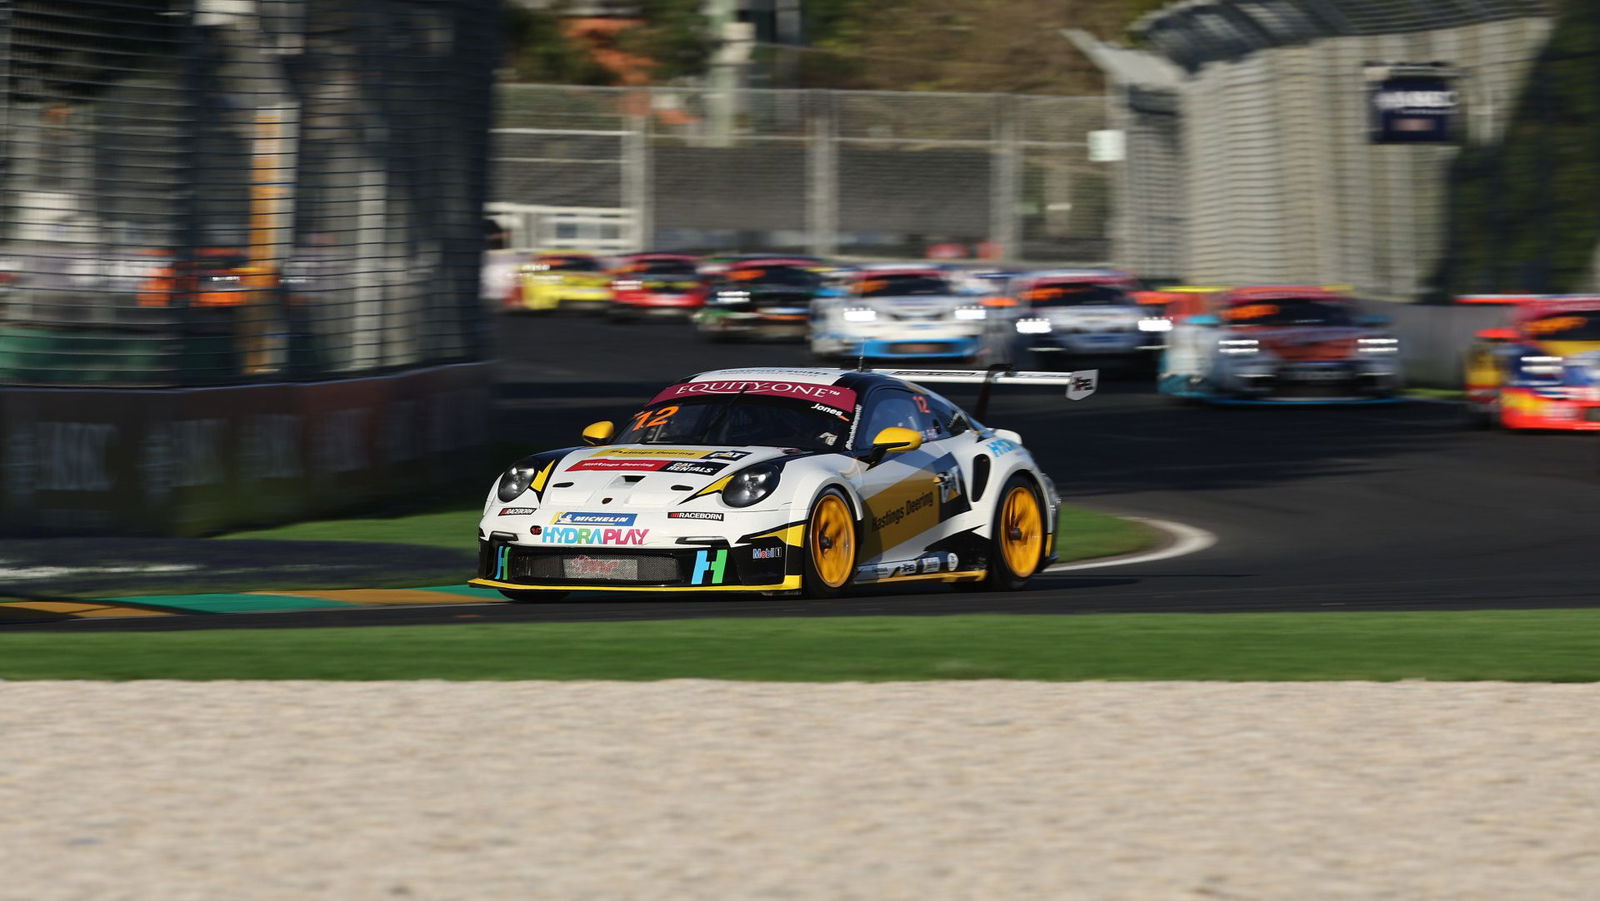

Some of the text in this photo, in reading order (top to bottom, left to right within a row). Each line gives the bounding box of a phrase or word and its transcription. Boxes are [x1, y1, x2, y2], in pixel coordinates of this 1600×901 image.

[811, 403, 843, 417] Jones
[631, 406, 680, 432] 12
[666, 465, 714, 474] RENTALS
[678, 513, 723, 521] RACEBORN
[872, 492, 934, 531] Hastings Deering
[542, 527, 650, 545] HYDRAPLAY
[753, 548, 774, 559] Mobil
